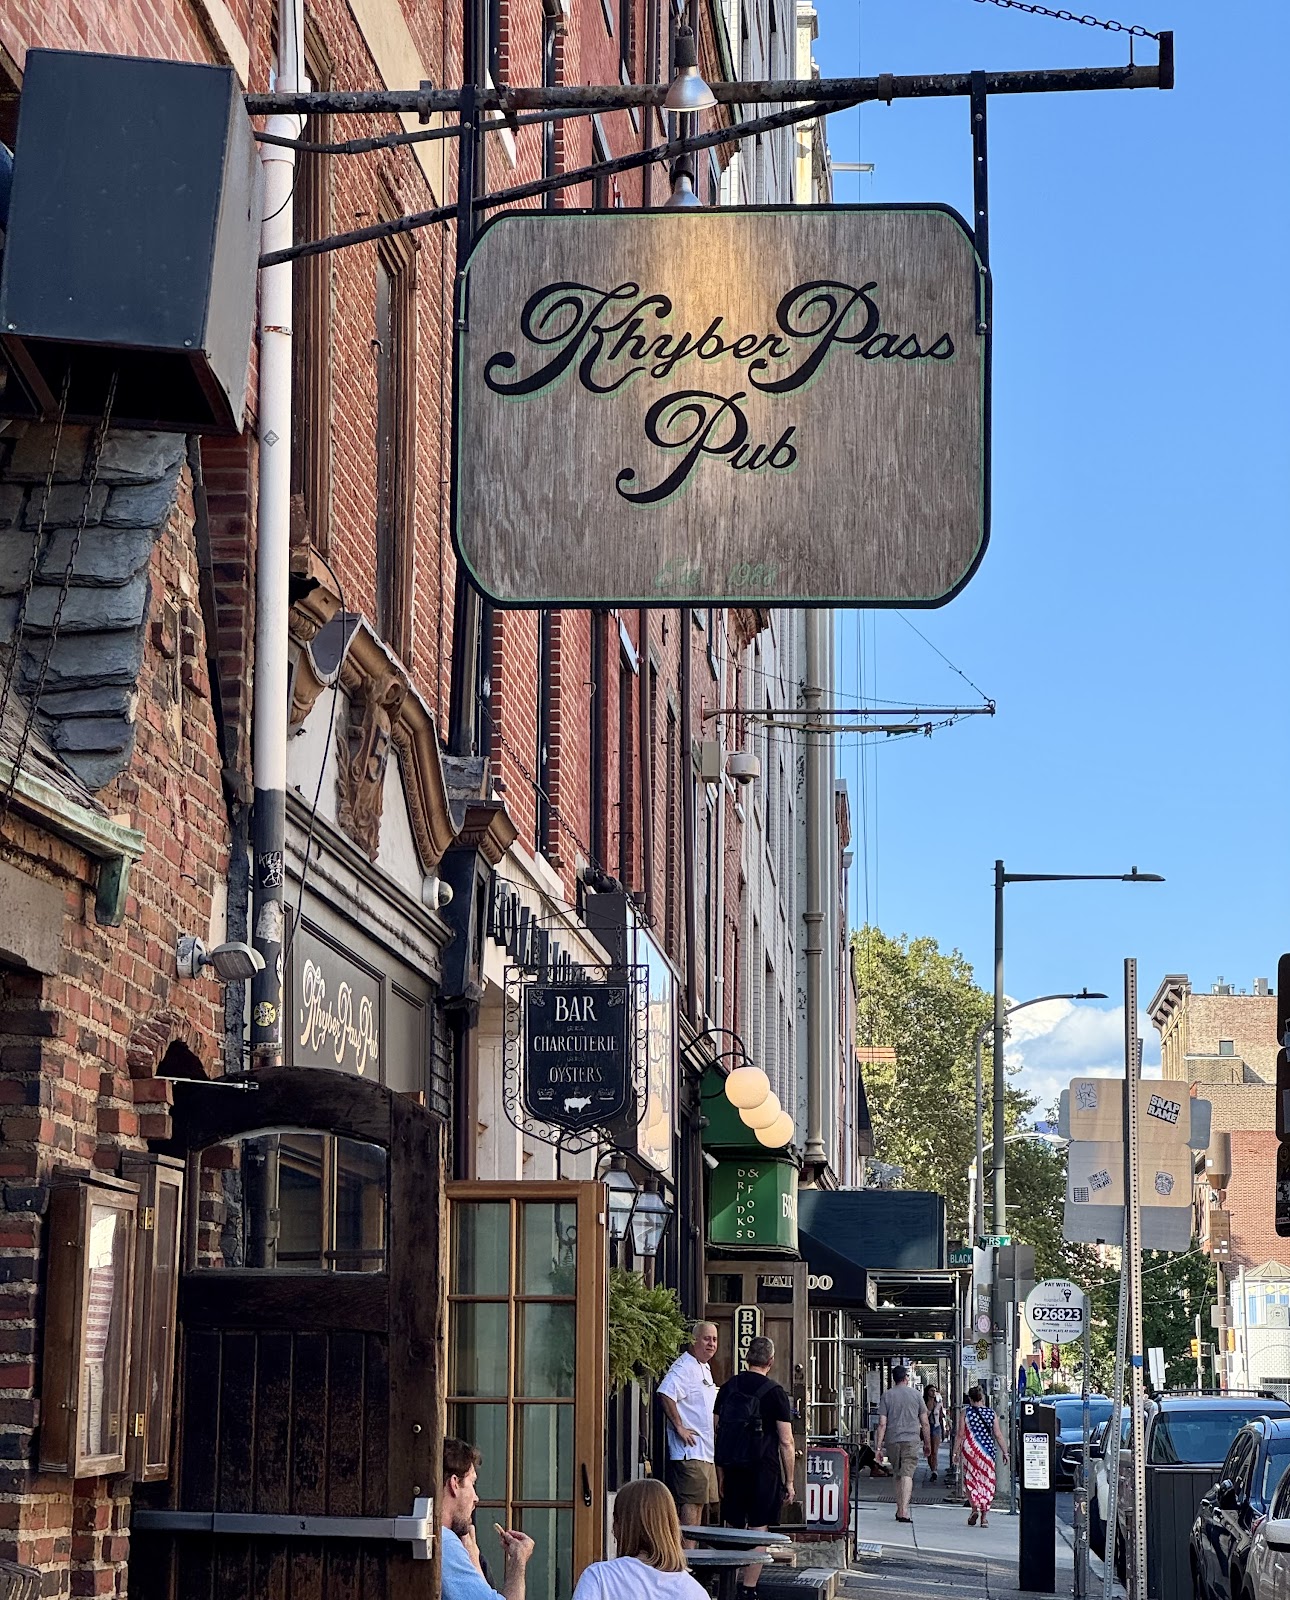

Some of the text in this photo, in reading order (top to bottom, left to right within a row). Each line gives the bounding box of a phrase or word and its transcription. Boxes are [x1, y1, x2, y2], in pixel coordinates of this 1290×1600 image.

[484, 280, 955, 396] Khyber Pass
[615, 390, 797, 504] Pub
[301, 959, 379, 1076] Khyber Pass Pub
[555, 996, 598, 1022] BAR
[533, 1035, 619, 1052] CHARCUTERIE
[549, 1066, 603, 1083] OYSTERS
[1151, 1095, 1181, 1113] SNAP
[736, 1168, 746, 1239] DRINKS
[746, 1184, 756, 1239] FOOD
[950, 1254, 973, 1264] BLACK
[762, 1274, 833, 1290] TATOO
[1033, 1307, 1081, 1321] 926823
[1024, 1403, 1034, 1416] B
[805, 1454, 834, 1480] ity
